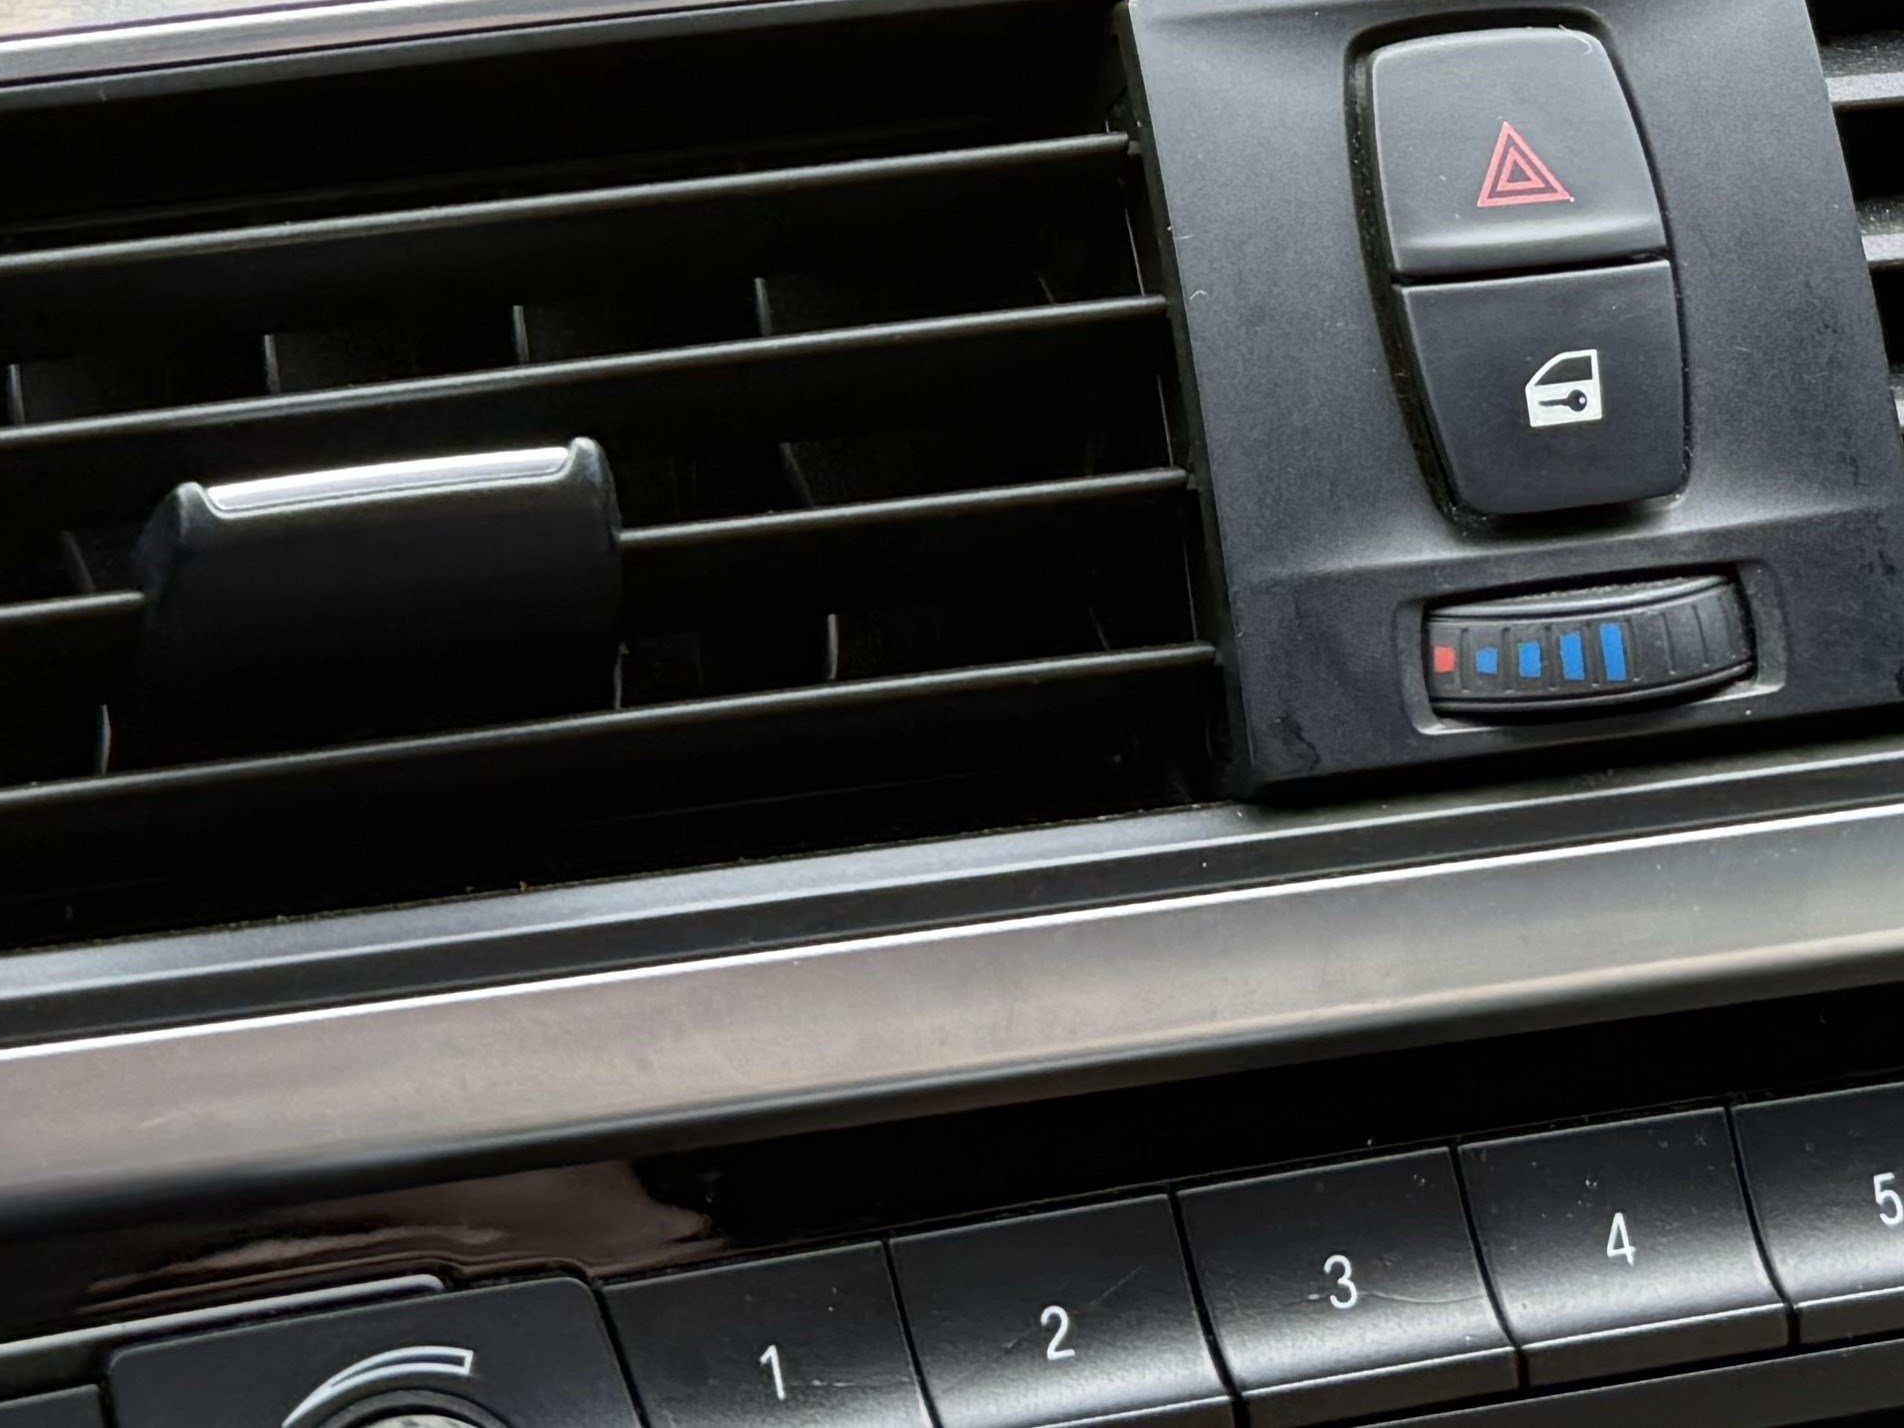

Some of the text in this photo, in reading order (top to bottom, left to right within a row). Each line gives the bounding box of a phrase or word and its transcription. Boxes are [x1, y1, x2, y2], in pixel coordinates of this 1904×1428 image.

[1604, 1211, 1638, 1267] 4
[1322, 1253, 1360, 1310] 3
[1039, 1303, 1076, 1362] 2
[759, 1344, 787, 1402] 1
